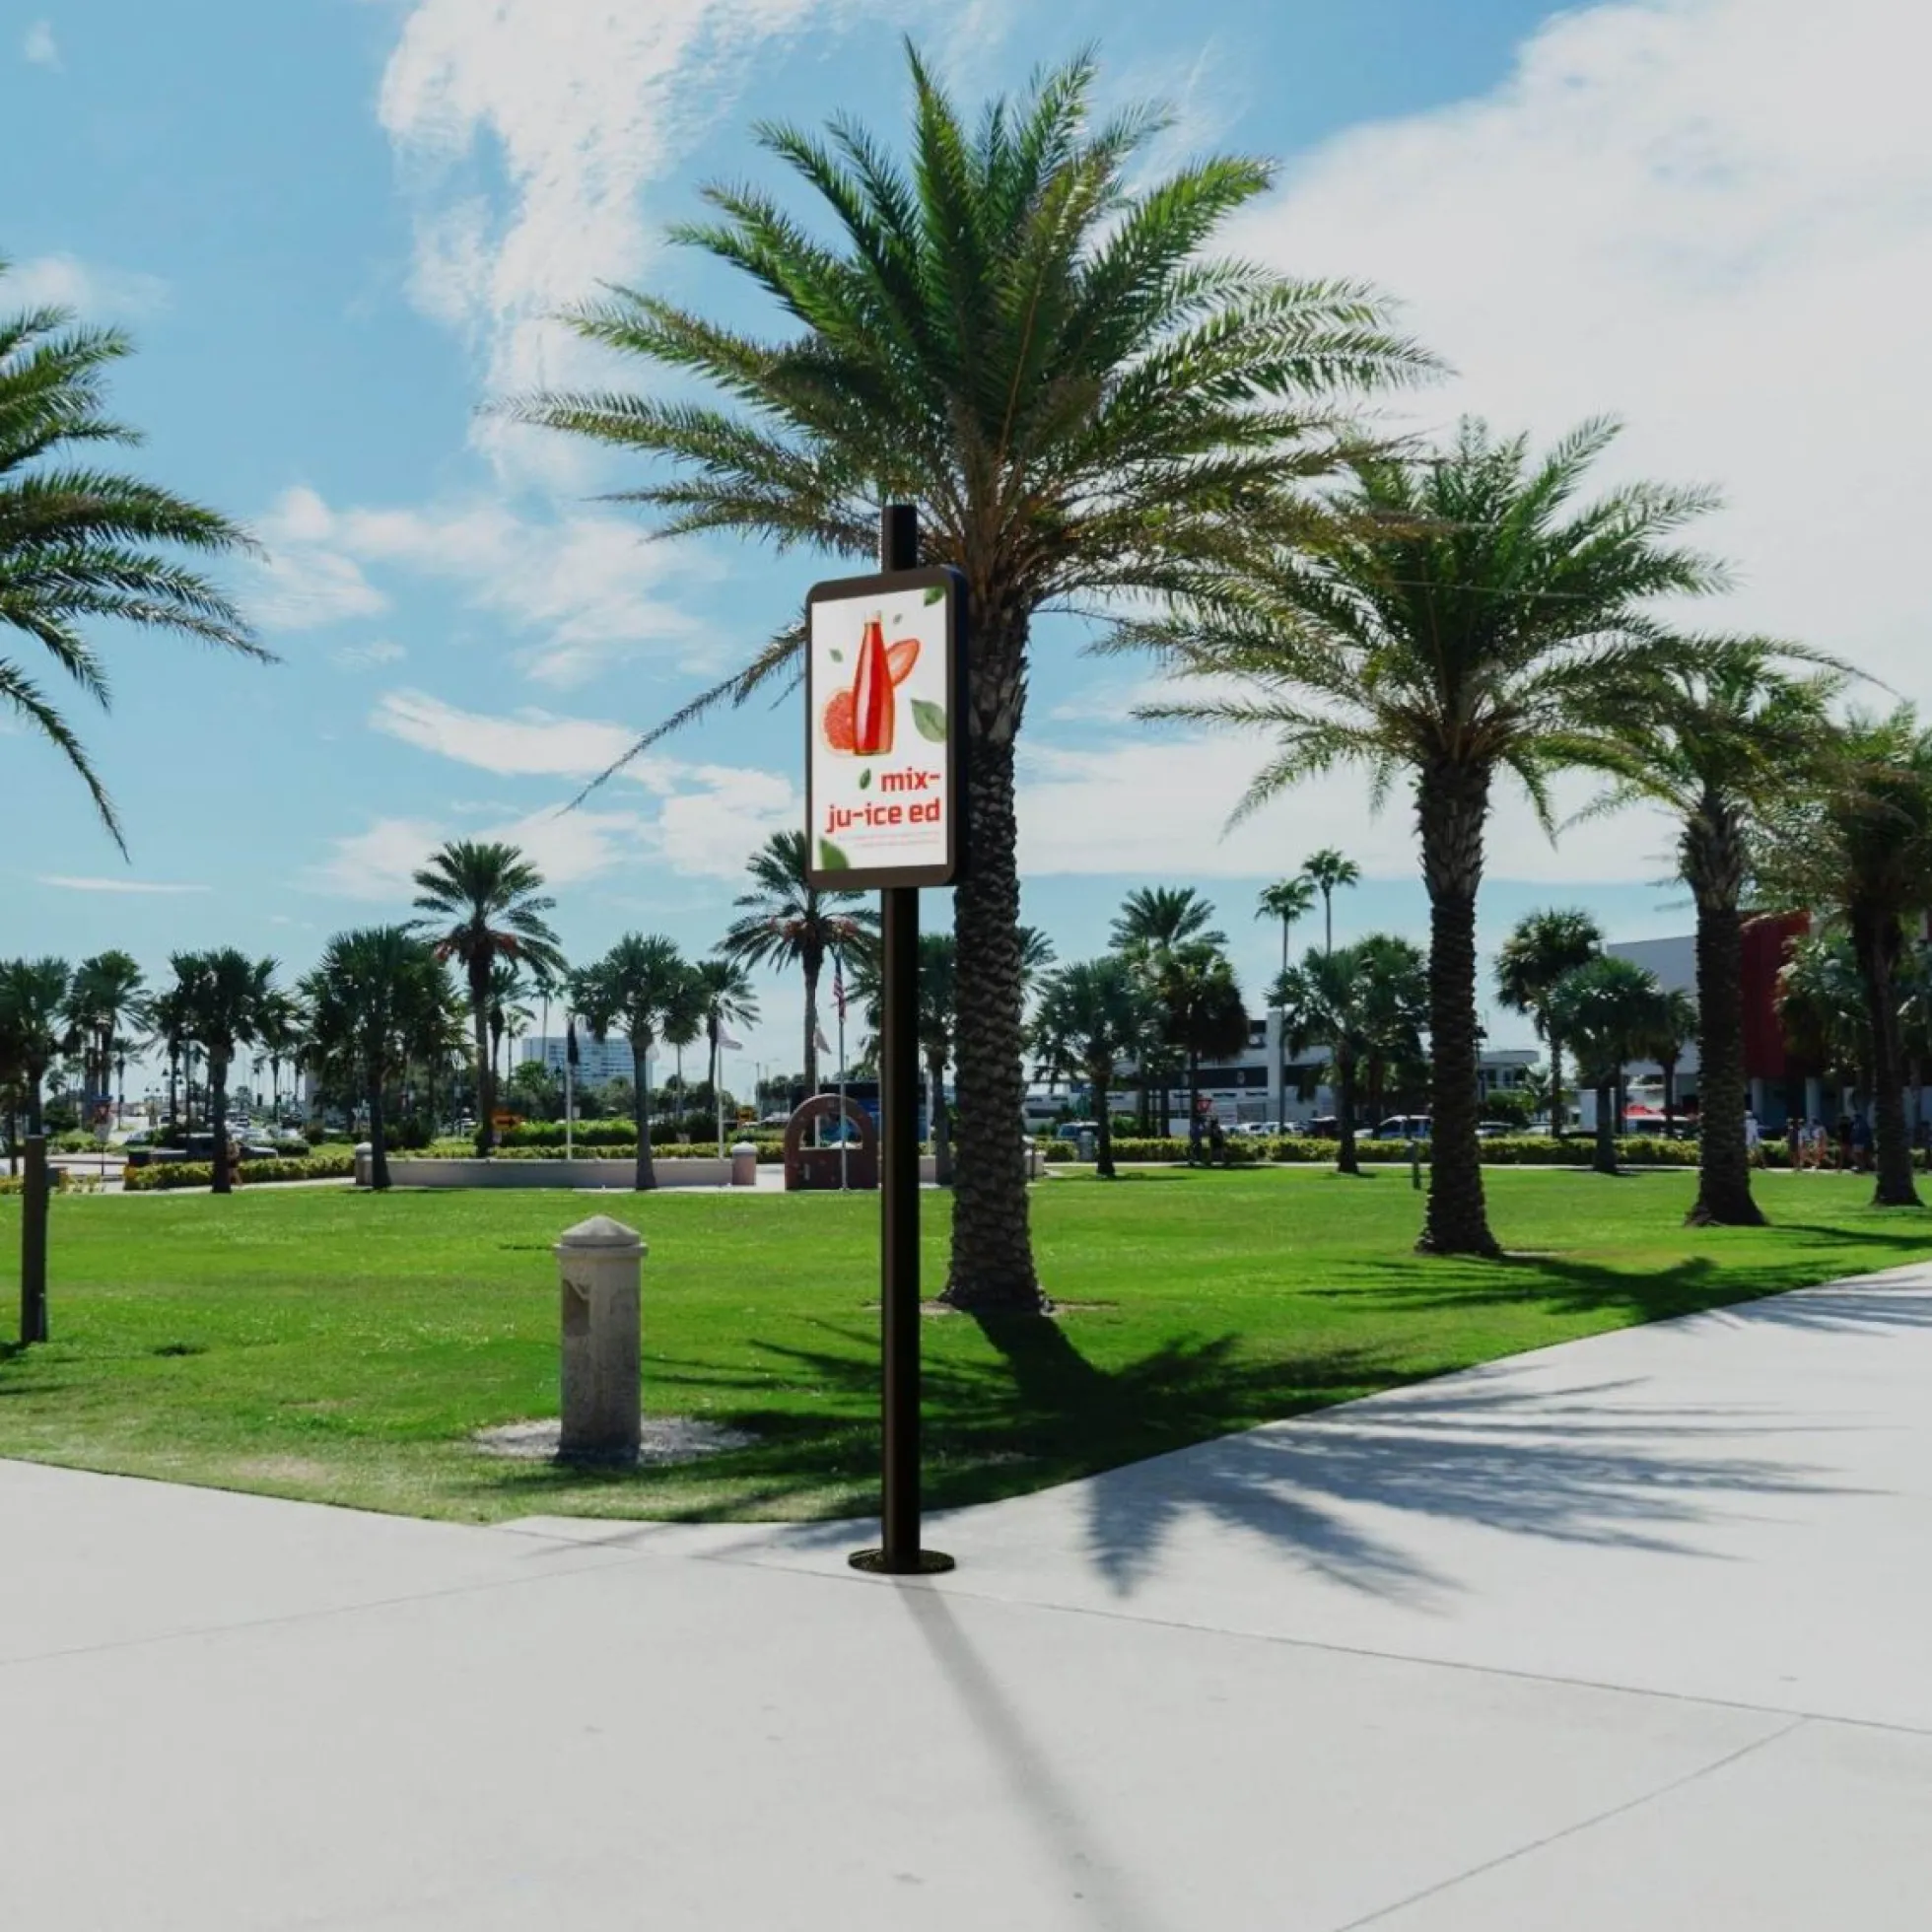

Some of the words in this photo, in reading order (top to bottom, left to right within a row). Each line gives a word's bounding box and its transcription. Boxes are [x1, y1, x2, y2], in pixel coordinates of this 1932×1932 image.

[880, 766, 940, 792] mix-
[825, 801, 902, 834] ju-ice
[909, 797, 940, 823] ed
